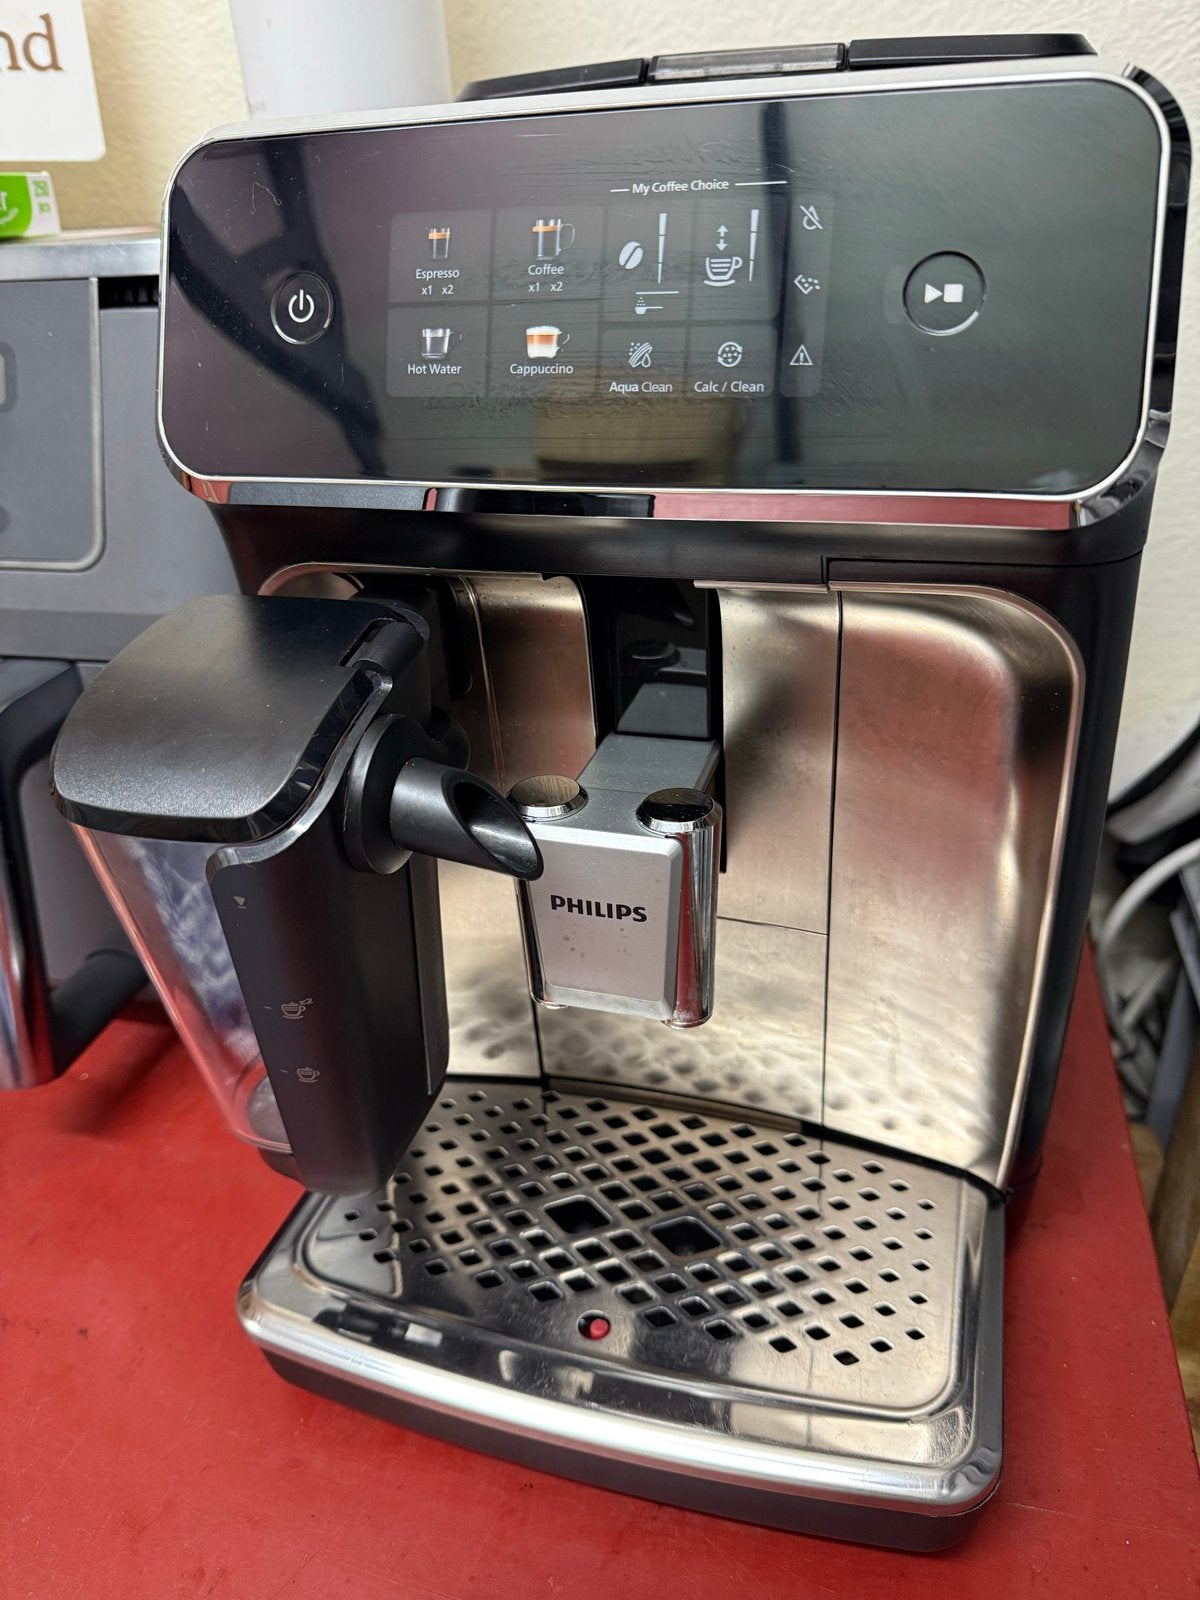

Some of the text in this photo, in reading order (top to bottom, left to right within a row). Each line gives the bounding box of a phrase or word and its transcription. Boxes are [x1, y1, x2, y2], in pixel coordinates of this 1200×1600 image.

[632, 179, 729, 196] My Coffee Choice
[415, 268, 460, 280] Espresso
[528, 264, 565, 275] Coffee
[421, 284, 454, 296] x1 x2
[528, 281, 563, 292] x1 x2
[407, 364, 462, 374] Hot Water
[509, 363, 574, 375] Cappuccino
[609, 381, 673, 394] Aqua Clean
[694, 381, 718, 392] Calc
[729, 381, 765, 393] Clean
[550, 894, 647, 922] PHILIPS
